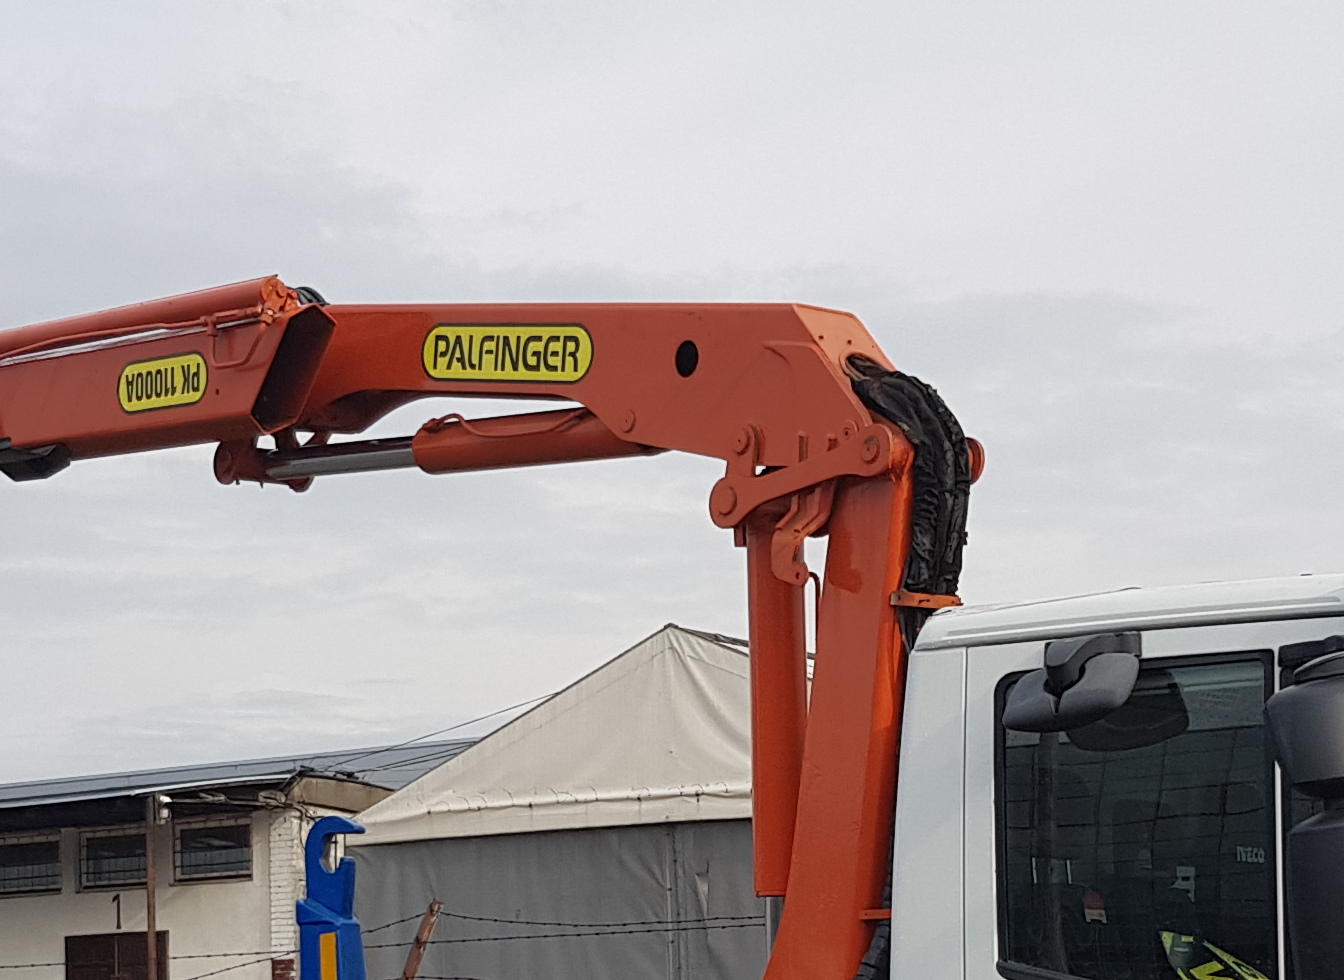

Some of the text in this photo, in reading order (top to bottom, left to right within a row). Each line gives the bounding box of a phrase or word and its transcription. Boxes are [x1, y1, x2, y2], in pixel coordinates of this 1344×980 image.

[433, 334, 581, 373] PALFINGER
[125, 362, 201, 404] PK 11000A
[1236, 845, 1265, 864] IVECO
